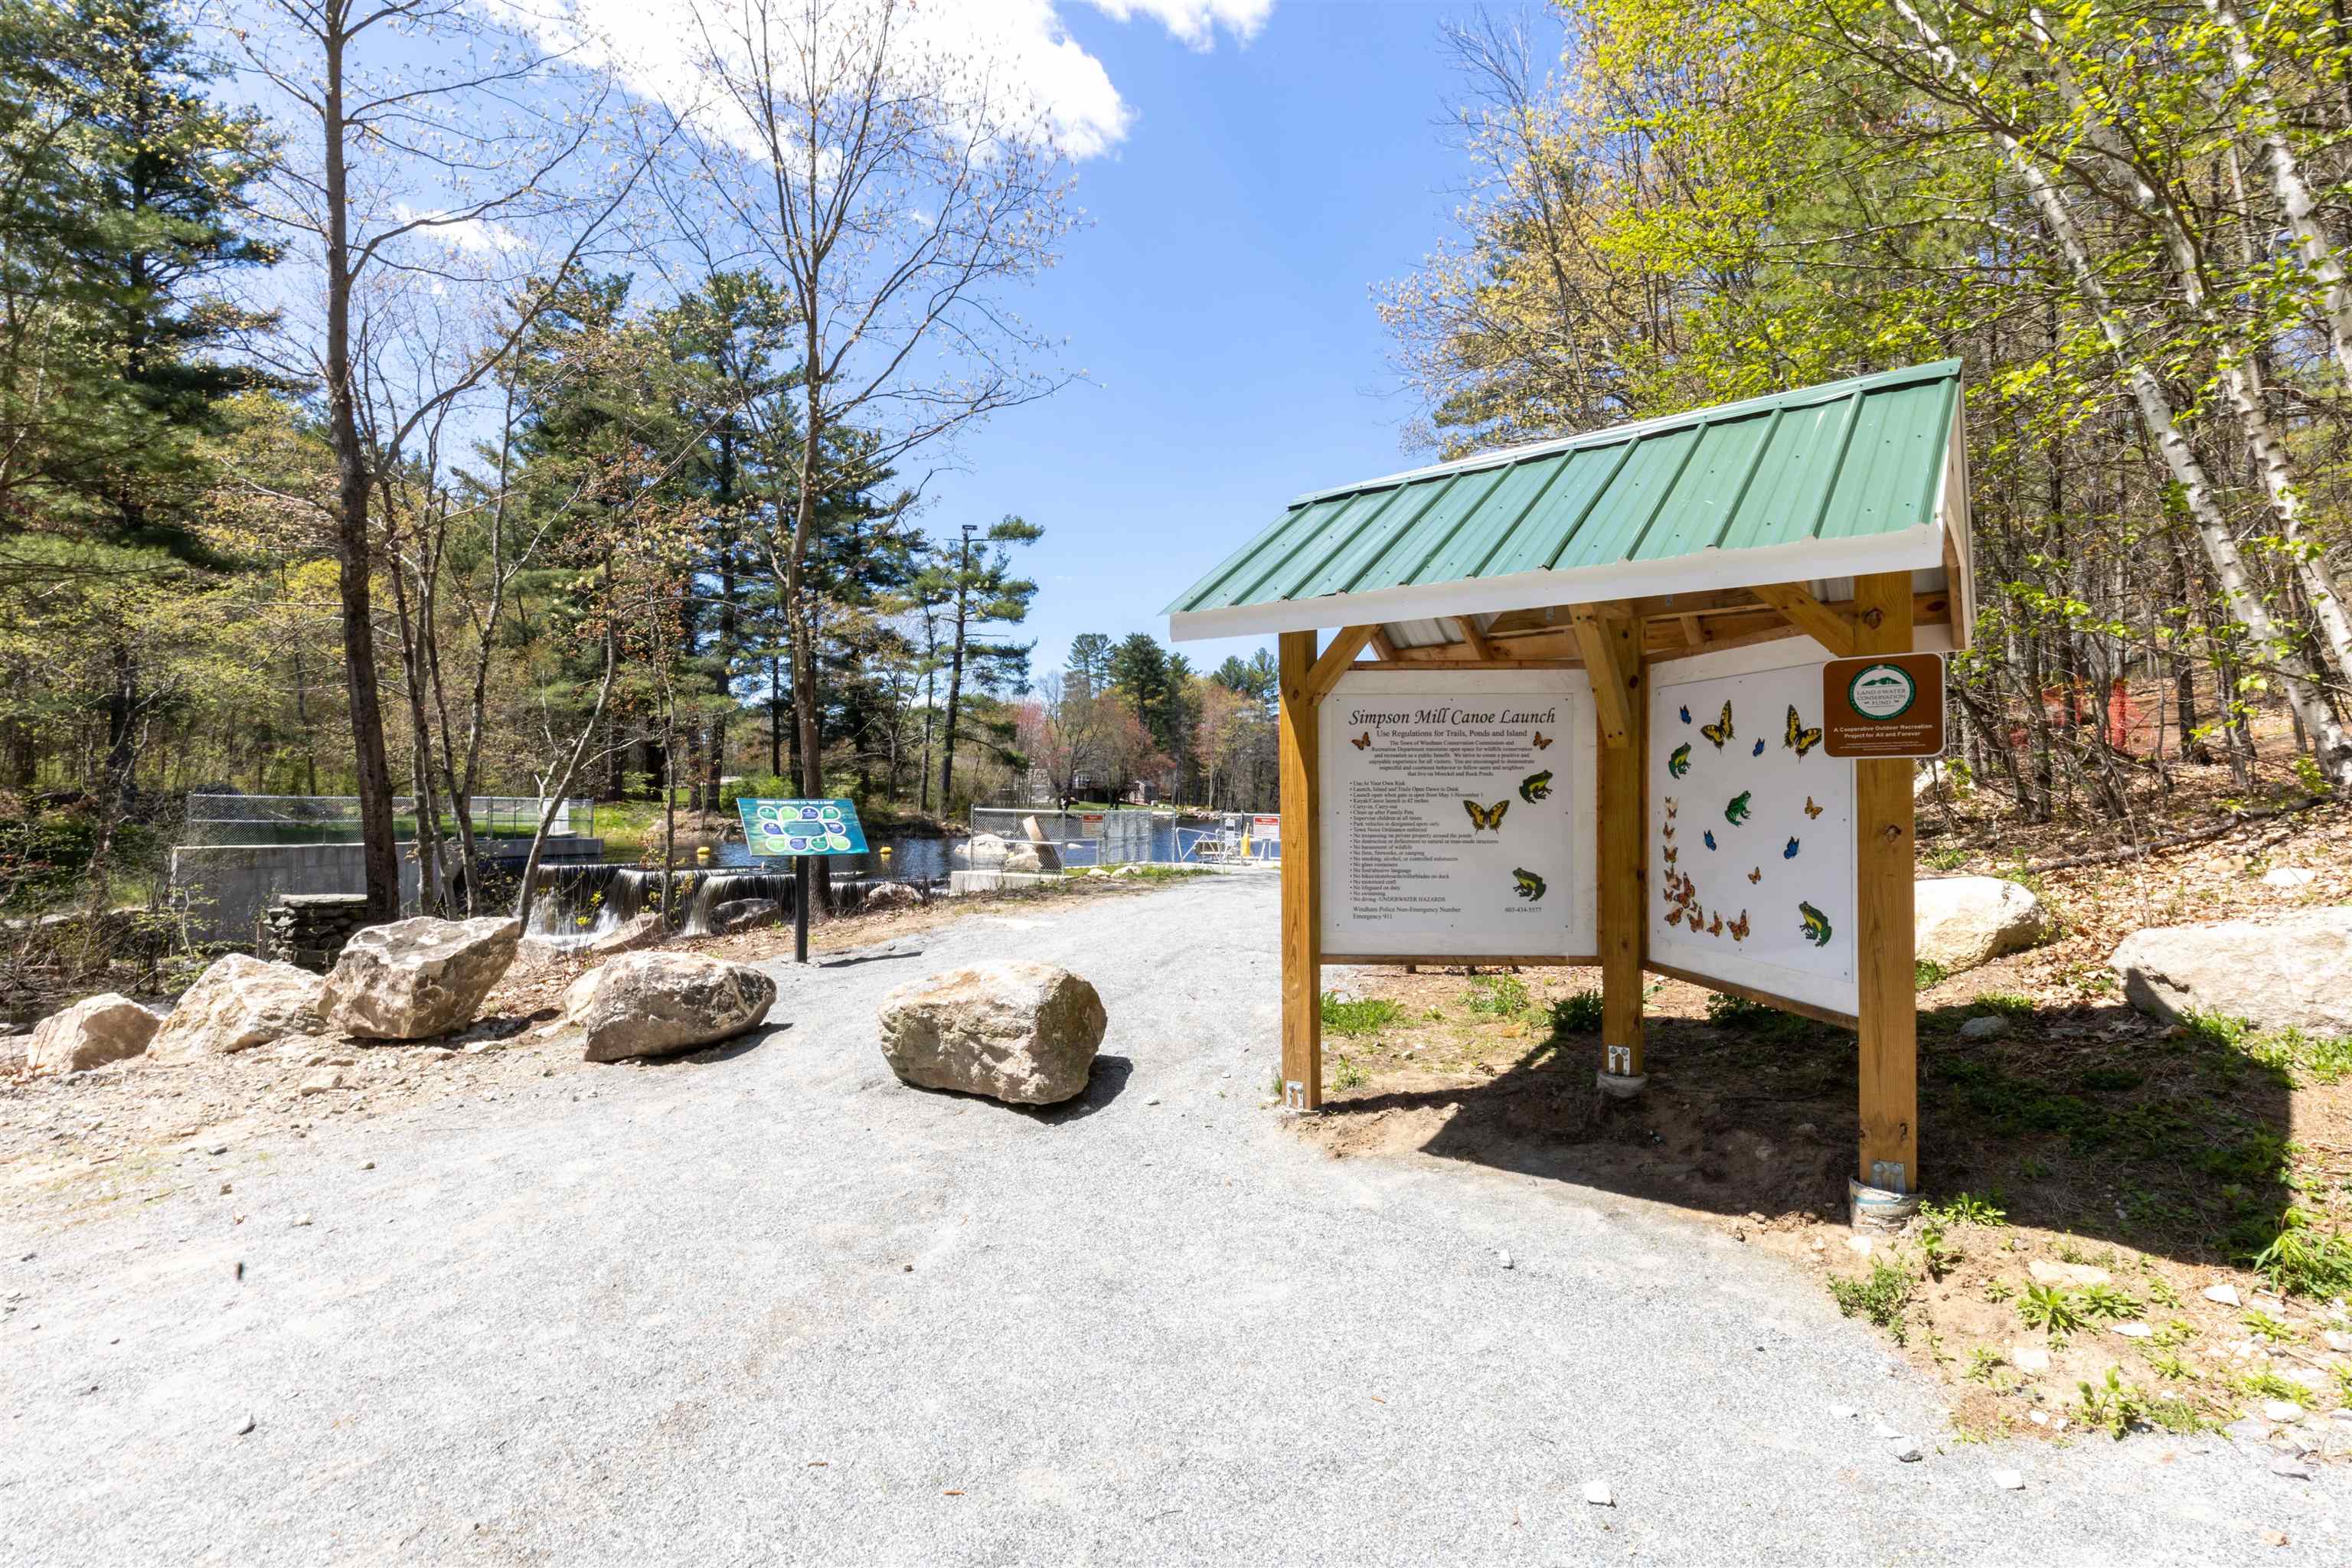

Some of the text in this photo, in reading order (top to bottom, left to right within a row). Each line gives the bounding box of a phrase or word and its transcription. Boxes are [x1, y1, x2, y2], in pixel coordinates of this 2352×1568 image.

[1348, 707, 1556, 728] Simpson Mill Canoe Launch
[1392, 729, 1432, 738] Regulations
